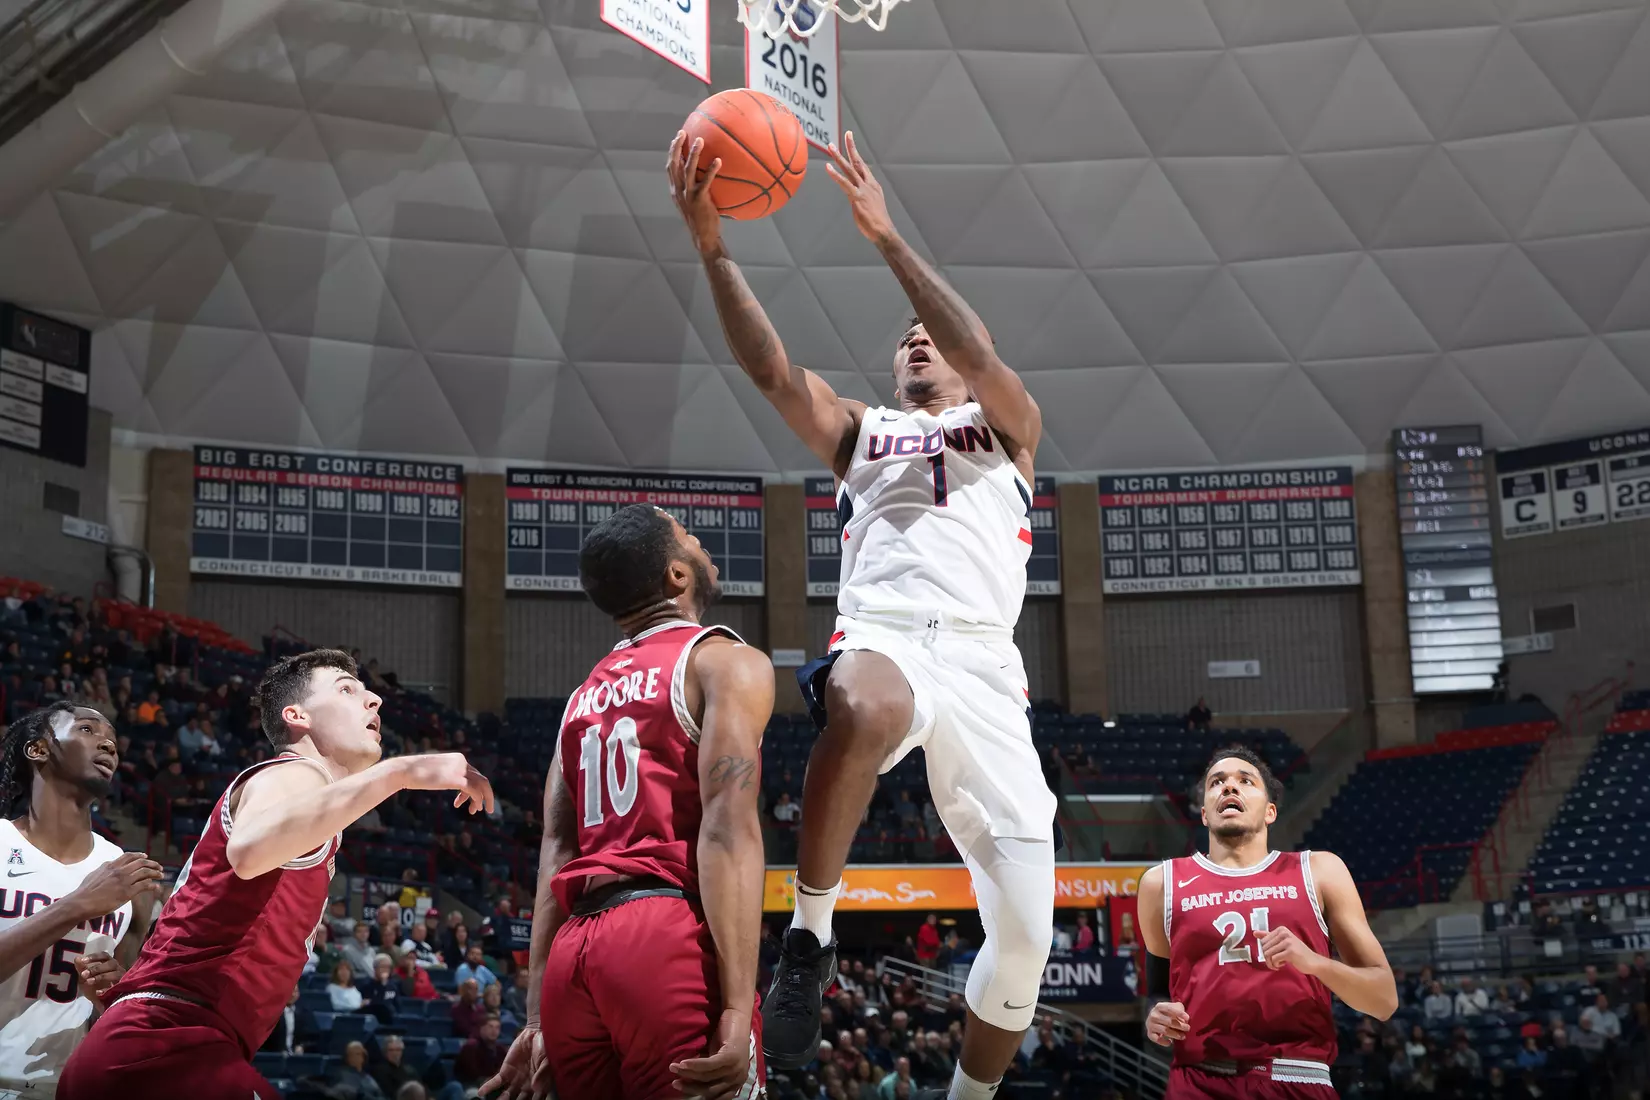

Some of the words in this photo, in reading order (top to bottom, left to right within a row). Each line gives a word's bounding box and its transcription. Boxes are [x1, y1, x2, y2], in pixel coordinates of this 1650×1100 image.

[628, 0, 690, 40] TIONAL
[616, 7, 696, 66] CHAMPIONS
[762, 31, 827, 98] 2016
[764, 74, 825, 122] NATIONAL
[868, 424, 994, 462] UCONN
[1589, 432, 1650, 452] UCONN
[200, 449, 237, 465] BIG
[248, 452, 306, 470] EAST
[316, 457, 457, 481] CONFERENCE
[927, 450, 948, 507] 1
[200, 466, 278, 483] REGULAR
[286, 472, 352, 488] SEASON
[360, 477, 457, 496] CHAMPIONS
[635, 478, 687, 489] ATHLETIC
[688, 480, 757, 492] CONFERENCE
[1113, 477, 1169, 492] NCAA
[1180, 470, 1338, 489] CHAMPIONSHIP
[1113, 490, 1218, 505] TOURNAMENT
[1226, 485, 1342, 500] APPEARANCES
[531, 487, 639, 503] TOURNAMENT
[647, 493, 739, 506] CHAMPIONS
[1514, 498, 1538, 523] C
[1573, 490, 1588, 514] 9
[731, 511, 759, 528] 2011
[811, 512, 838, 529] 1955
[511, 528, 539, 547] 2016
[198, 559, 304, 577] CONNECTICUT
[361, 569, 453, 585] BASKETBALL
[514, 578, 579, 588] CONNECT
[1111, 578, 1207, 592] CONNECTICUT
[569, 666, 661, 724] MOORE
[579, 716, 641, 828] 10
[0, 887, 125, 940] UCNN
[1180, 892, 1224, 913] SAINT
[1224, 885, 1298, 905] JOSEPH'S
[1212, 907, 1270, 966] 21
[25, 938, 87, 1004] 15
[1040, 962, 1103, 987] ONN
